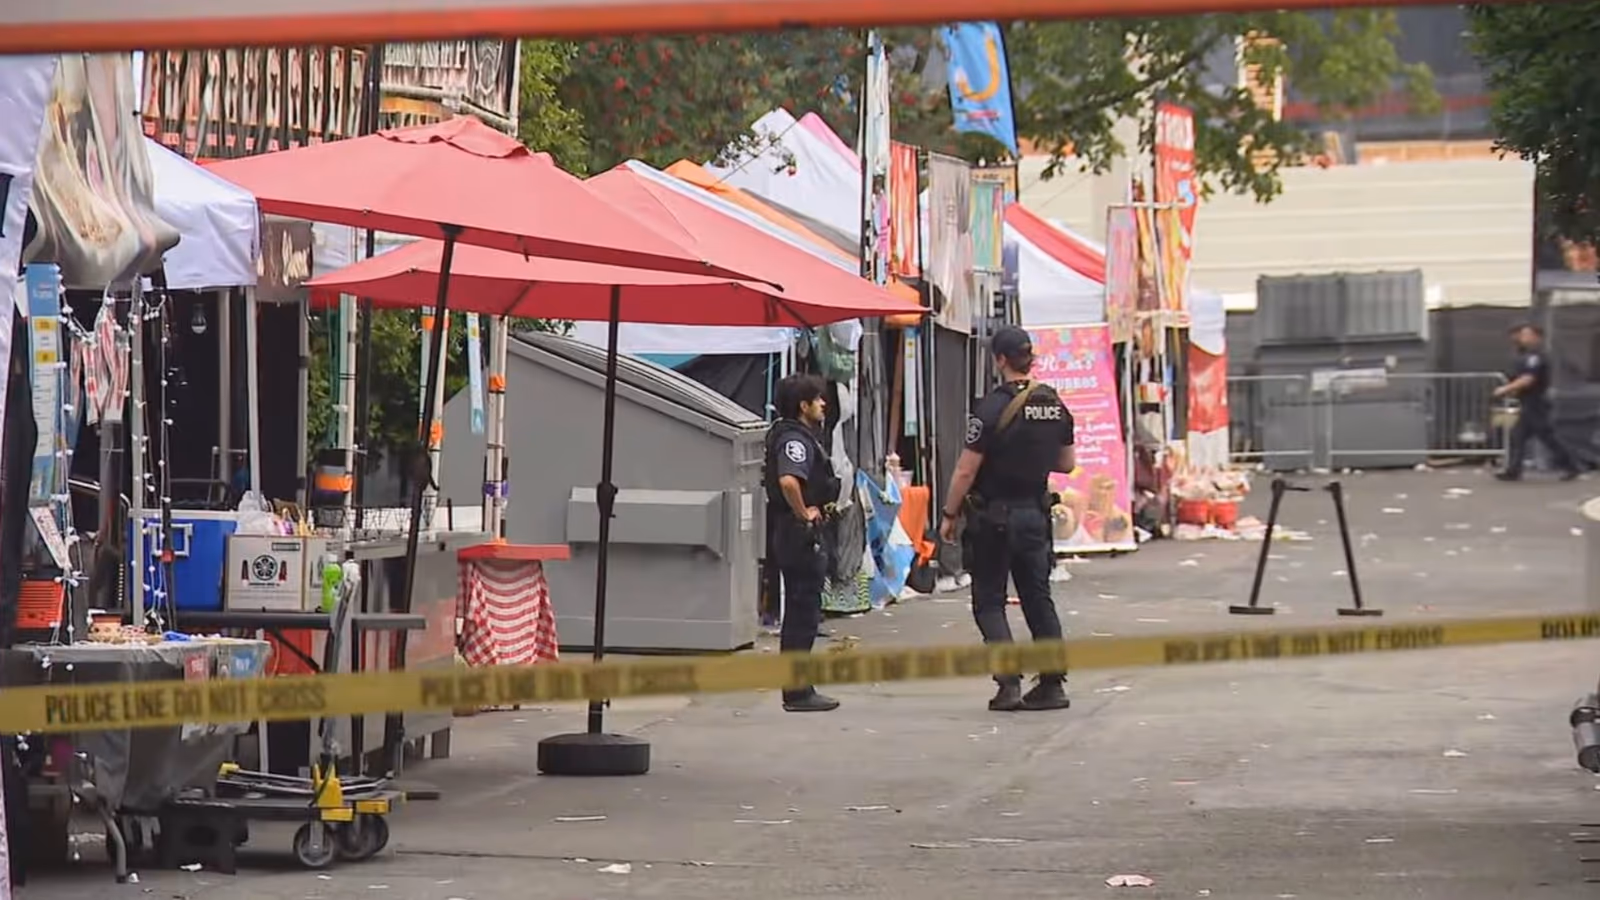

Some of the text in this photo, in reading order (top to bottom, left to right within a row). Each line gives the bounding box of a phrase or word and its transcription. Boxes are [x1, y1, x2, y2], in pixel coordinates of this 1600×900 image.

[1025, 405, 1061, 420] POLICE
[45, 676, 326, 725] POLICE LINE DO NOT CROSS
